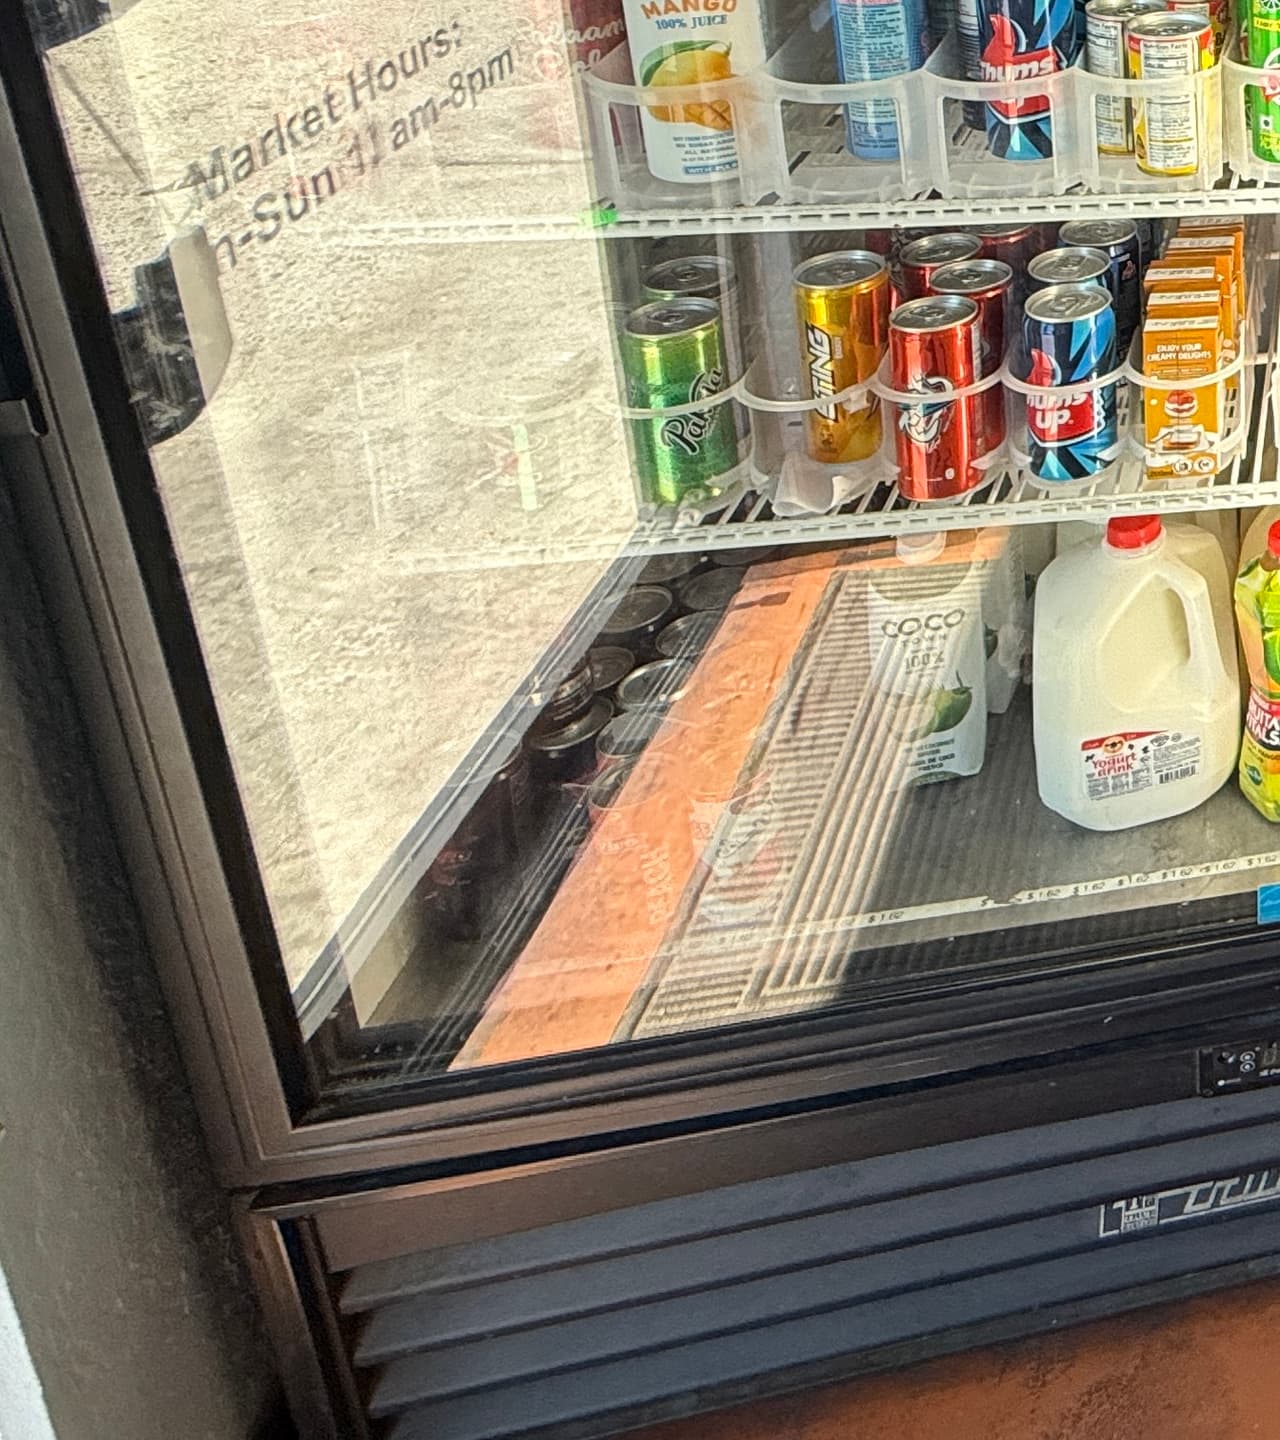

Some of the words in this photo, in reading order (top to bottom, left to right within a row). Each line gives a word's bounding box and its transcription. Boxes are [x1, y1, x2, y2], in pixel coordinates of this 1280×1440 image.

[655, 17, 688, 30] 100%
[690, 13, 728, 29] JUICE
[980, 56, 1056, 83] Thums
[186, 88, 338, 204] Market
[350, 17, 466, 111] Hours:
[881, 608, 966, 638] COCO
[904, 650, 945, 671] 100%
[1092, 751, 1137, 770] Yogurt
[1096, 761, 1134, 778] drink
